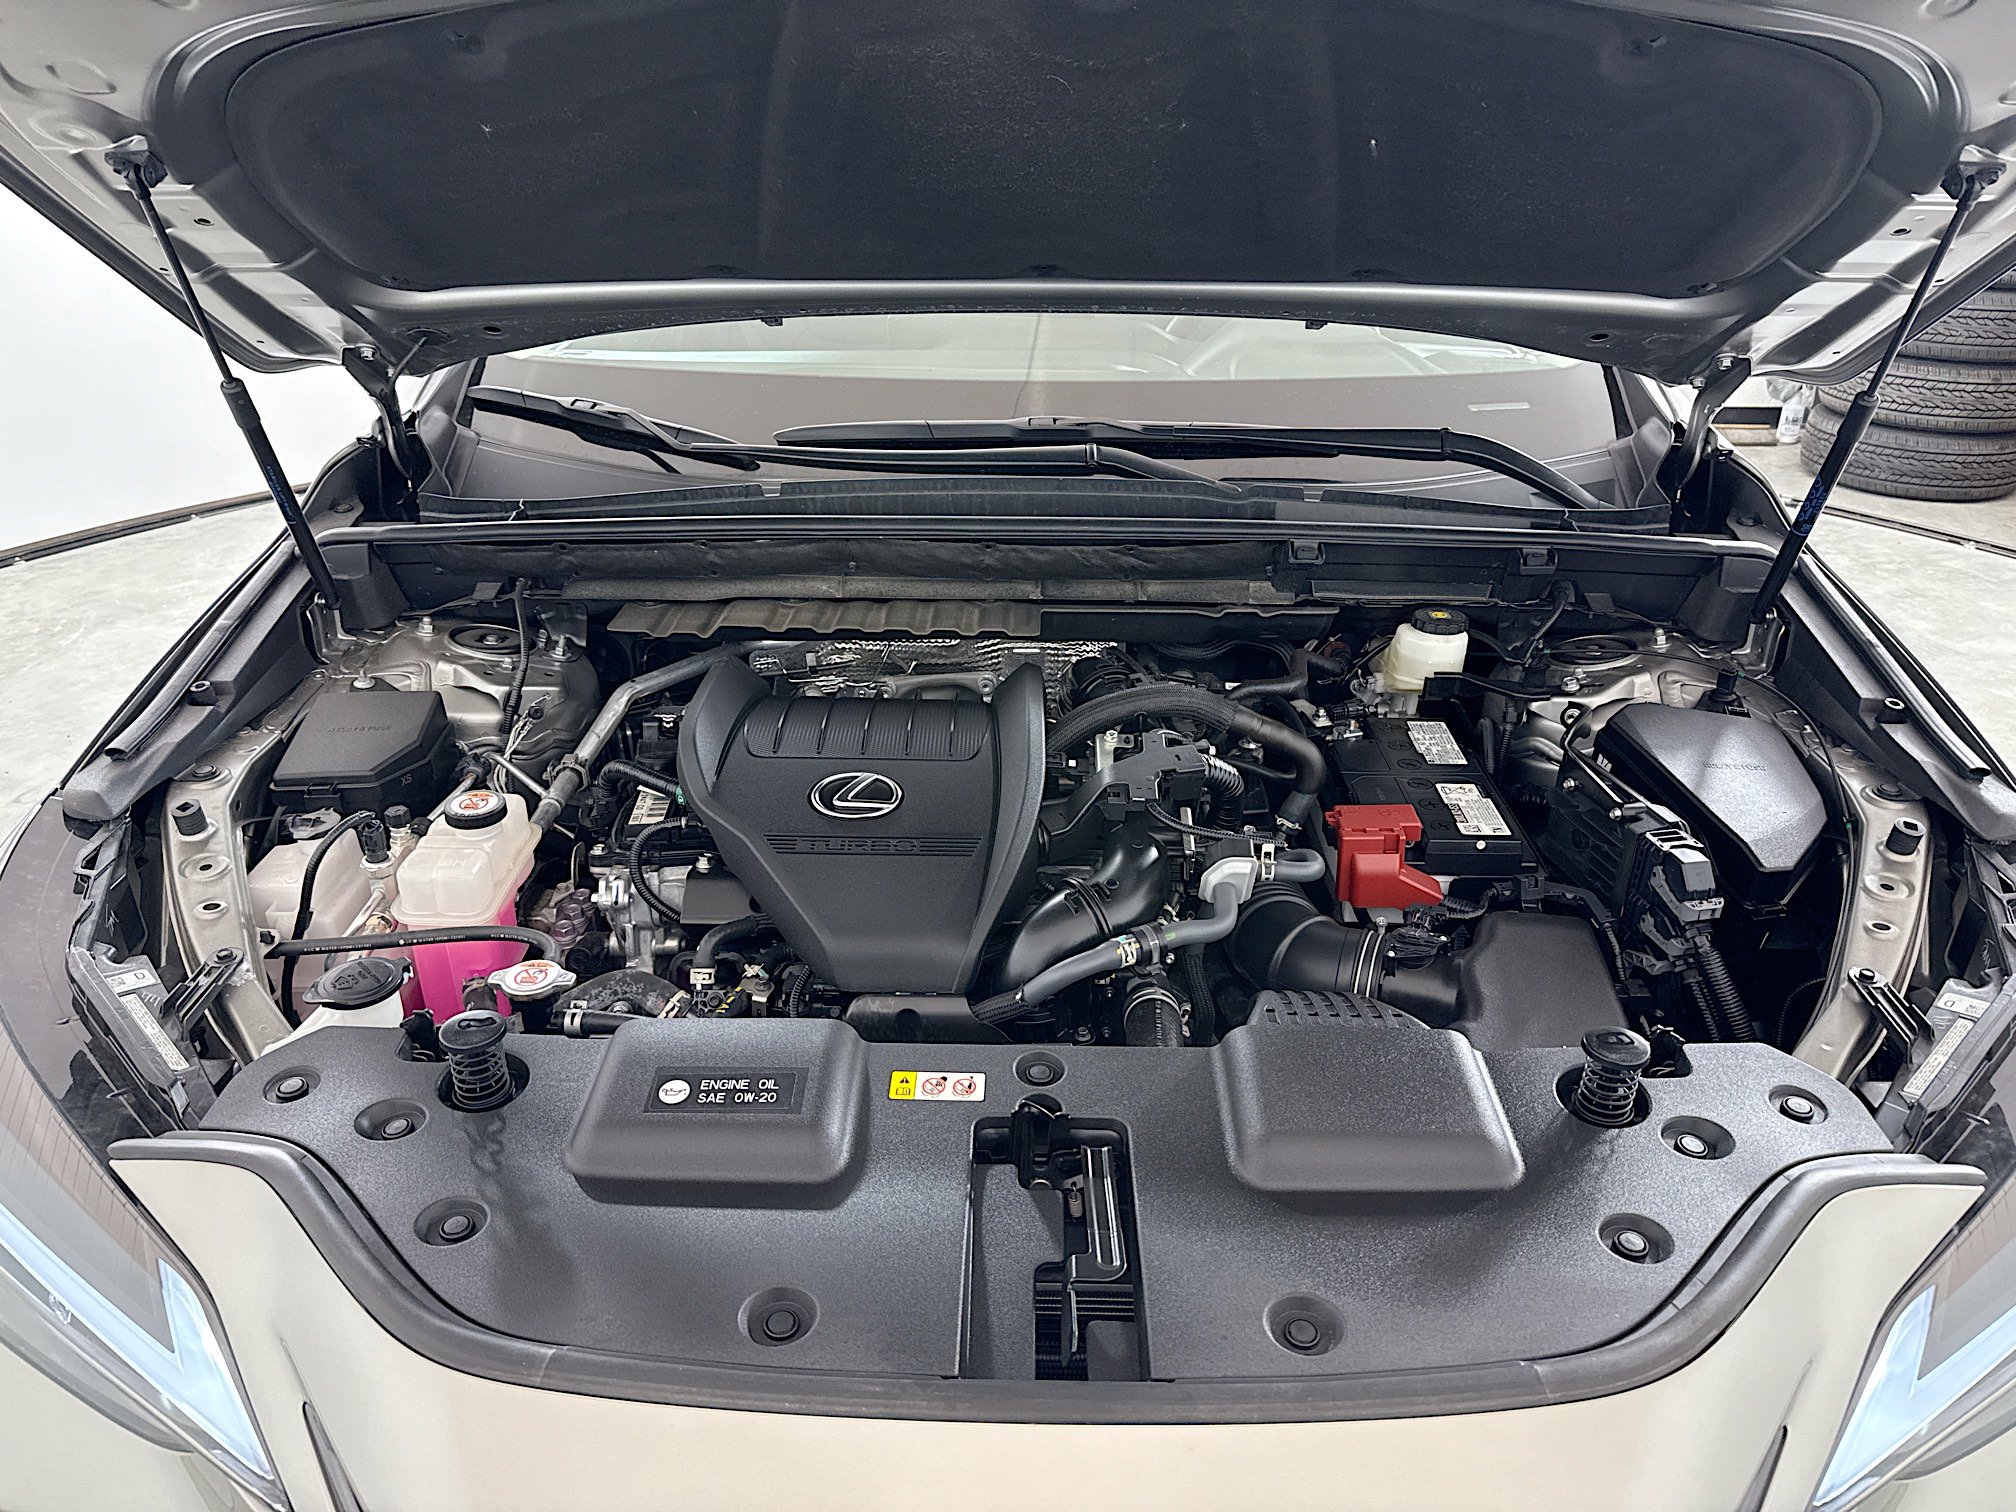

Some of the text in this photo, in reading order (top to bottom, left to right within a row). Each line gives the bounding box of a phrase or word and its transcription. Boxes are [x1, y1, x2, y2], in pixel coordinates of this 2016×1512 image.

[801, 839, 917, 852] TURBO
[700, 1078, 780, 1090] ENGINE OIL
[697, 1092, 778, 1104] SAE 0W-20
